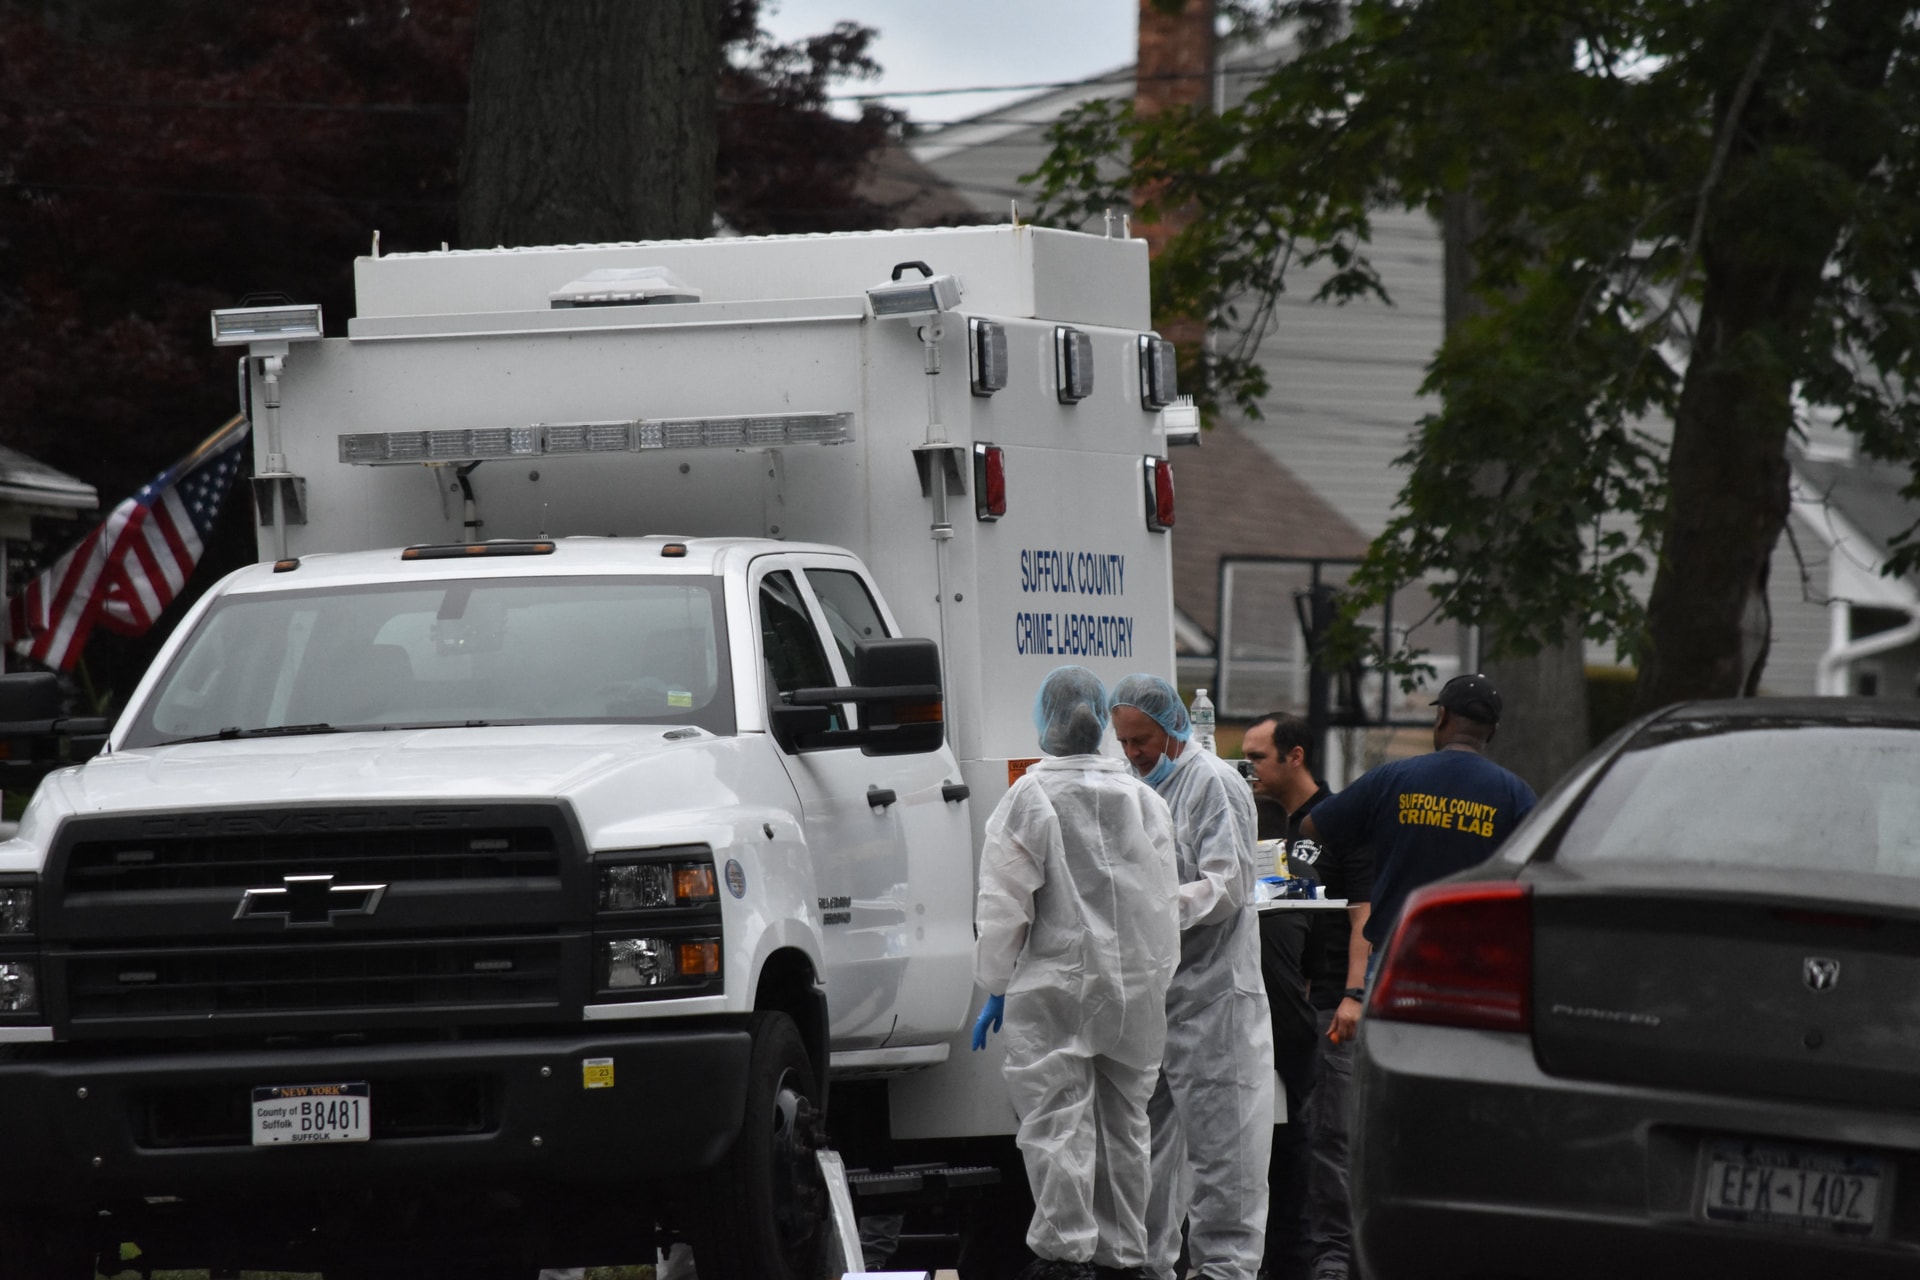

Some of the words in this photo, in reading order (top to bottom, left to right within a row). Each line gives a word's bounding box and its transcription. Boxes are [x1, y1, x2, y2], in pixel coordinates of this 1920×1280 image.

[1021, 549, 1076, 593] SUFFOLK
[1078, 551, 1124, 595] COUNTY
[1016, 611, 1054, 655] CRIME
[1056, 613, 1133, 658] LABORATORY
[1399, 793, 1448, 812] SUFFOLK
[1449, 798, 1497, 822] COUNTY
[1398, 809, 1453, 828] CRIME
[1457, 815, 1494, 838] LAB
[281, 1087, 308, 1097] NEW
[311, 1086, 340, 1096] YORK
[257, 1106, 287, 1118] County
[289, 1106, 298, 1115] of
[262, 1119, 293, 1130] Suffolk
[315, 1100, 359, 1131] 8481
[292, 1133, 330, 1141] SUFFOLK
